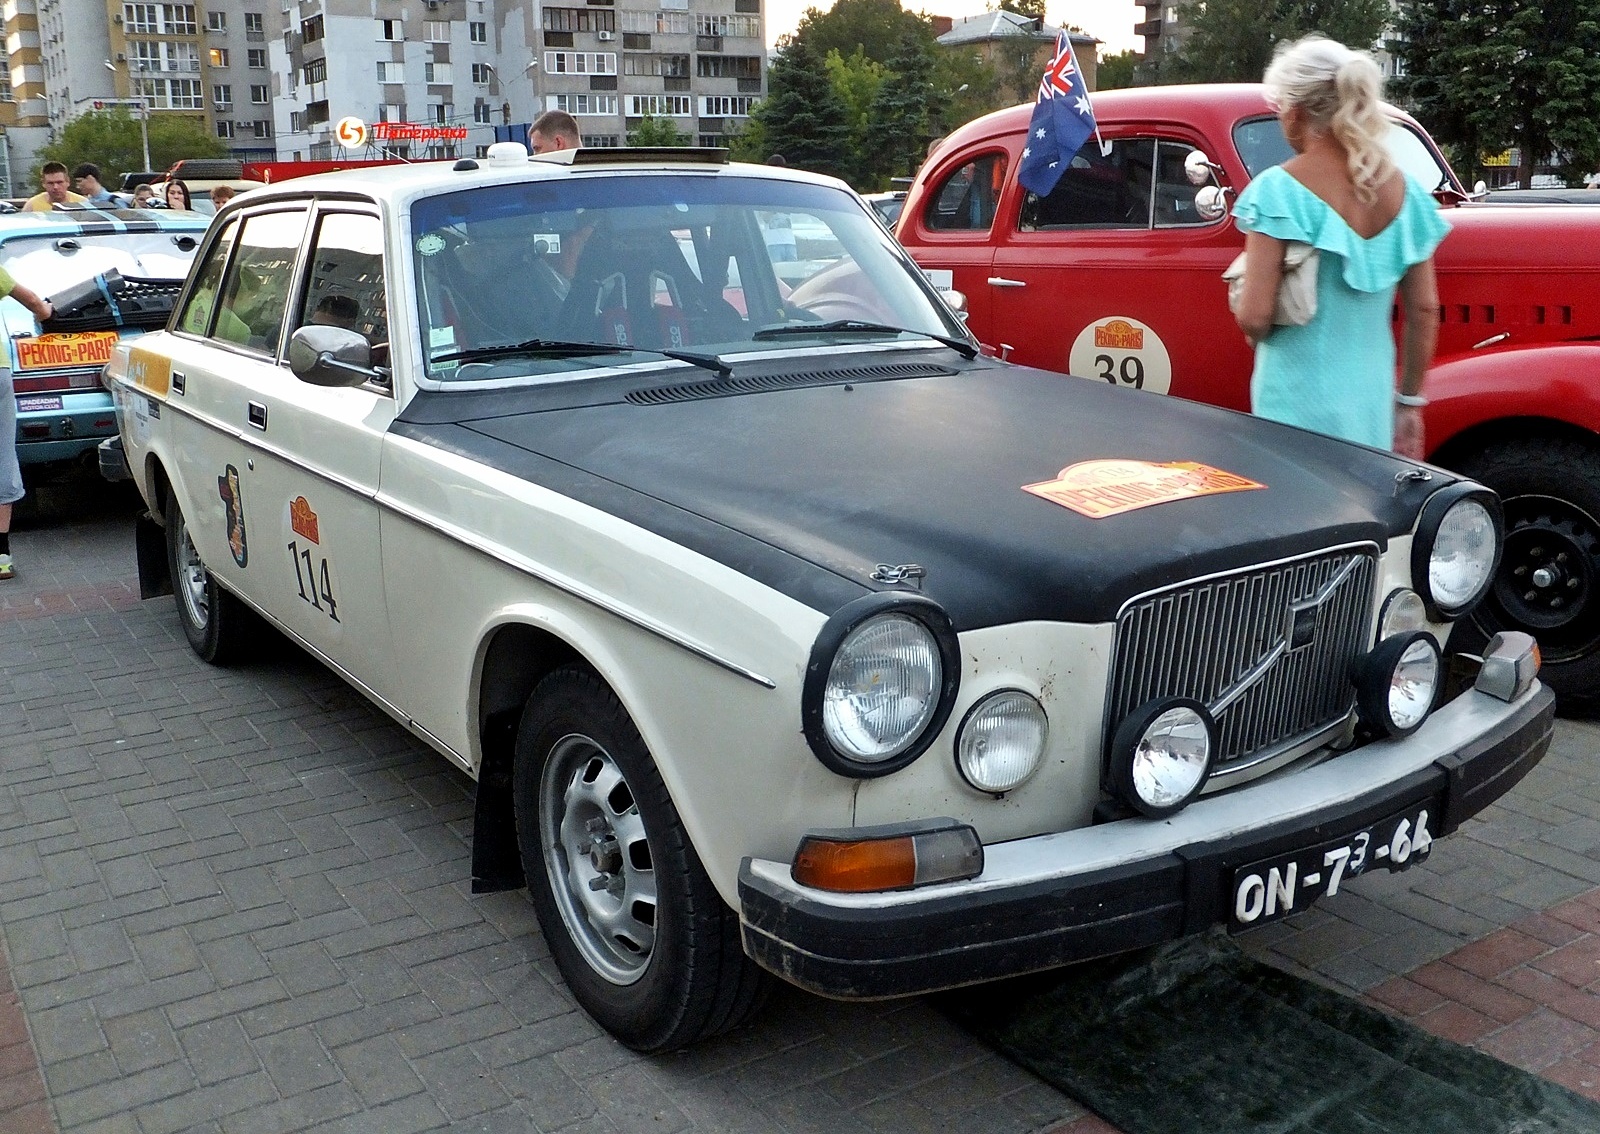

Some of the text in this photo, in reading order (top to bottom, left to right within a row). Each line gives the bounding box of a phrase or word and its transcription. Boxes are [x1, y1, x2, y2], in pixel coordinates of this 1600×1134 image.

[20, 343, 73, 366] PEKING
[1094, 354, 1145, 391] 39
[1043, 481, 1178, 513] PEKING
[287, 540, 340, 624] 114
